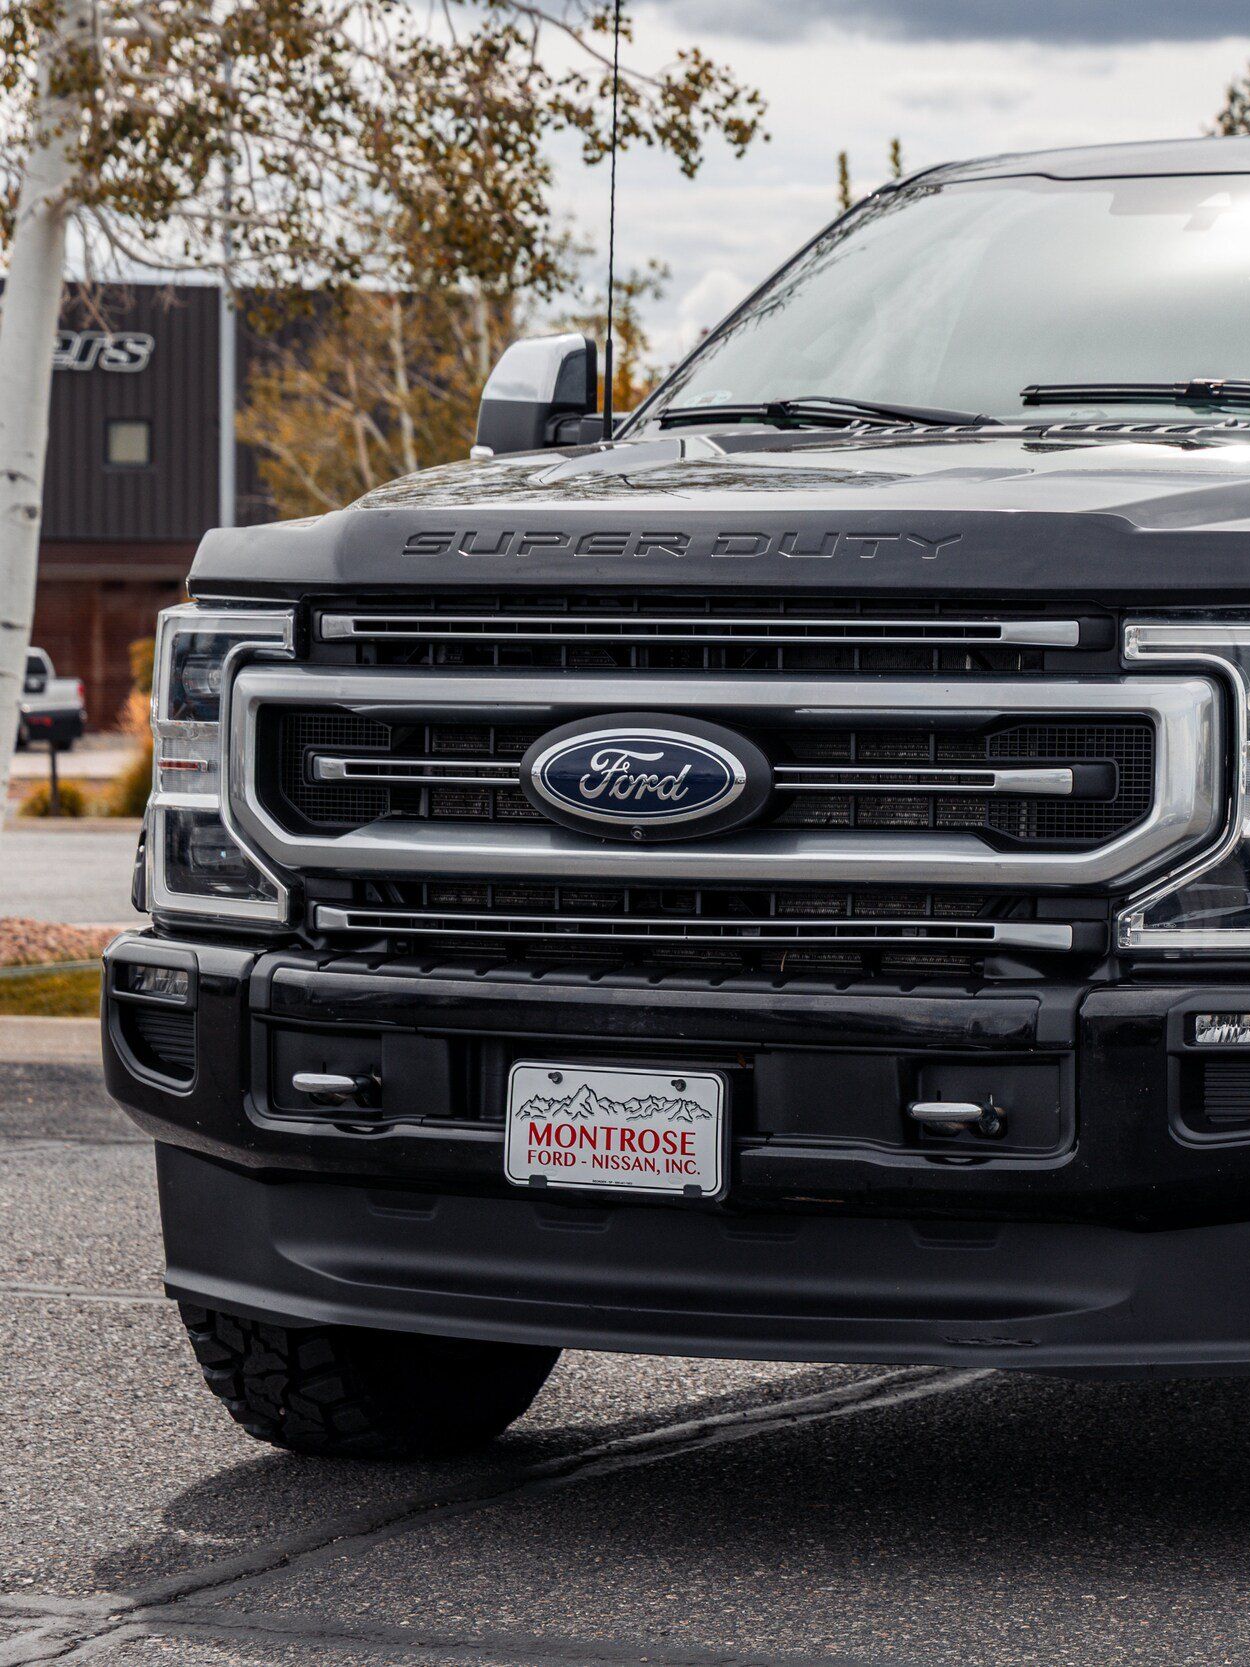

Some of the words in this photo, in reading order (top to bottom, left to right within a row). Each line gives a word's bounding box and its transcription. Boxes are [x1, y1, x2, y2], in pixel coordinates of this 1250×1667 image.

[401, 530, 692, 558] SUPER
[710, 531, 964, 560] DUTY
[578, 748, 692, 801] Ford
[528, 1121, 697, 1156] MONTROSE
[527, 1149, 577, 1168] FORD
[592, 1153, 661, 1175] NISSAN,
[665, 1158, 701, 1176] INC.
